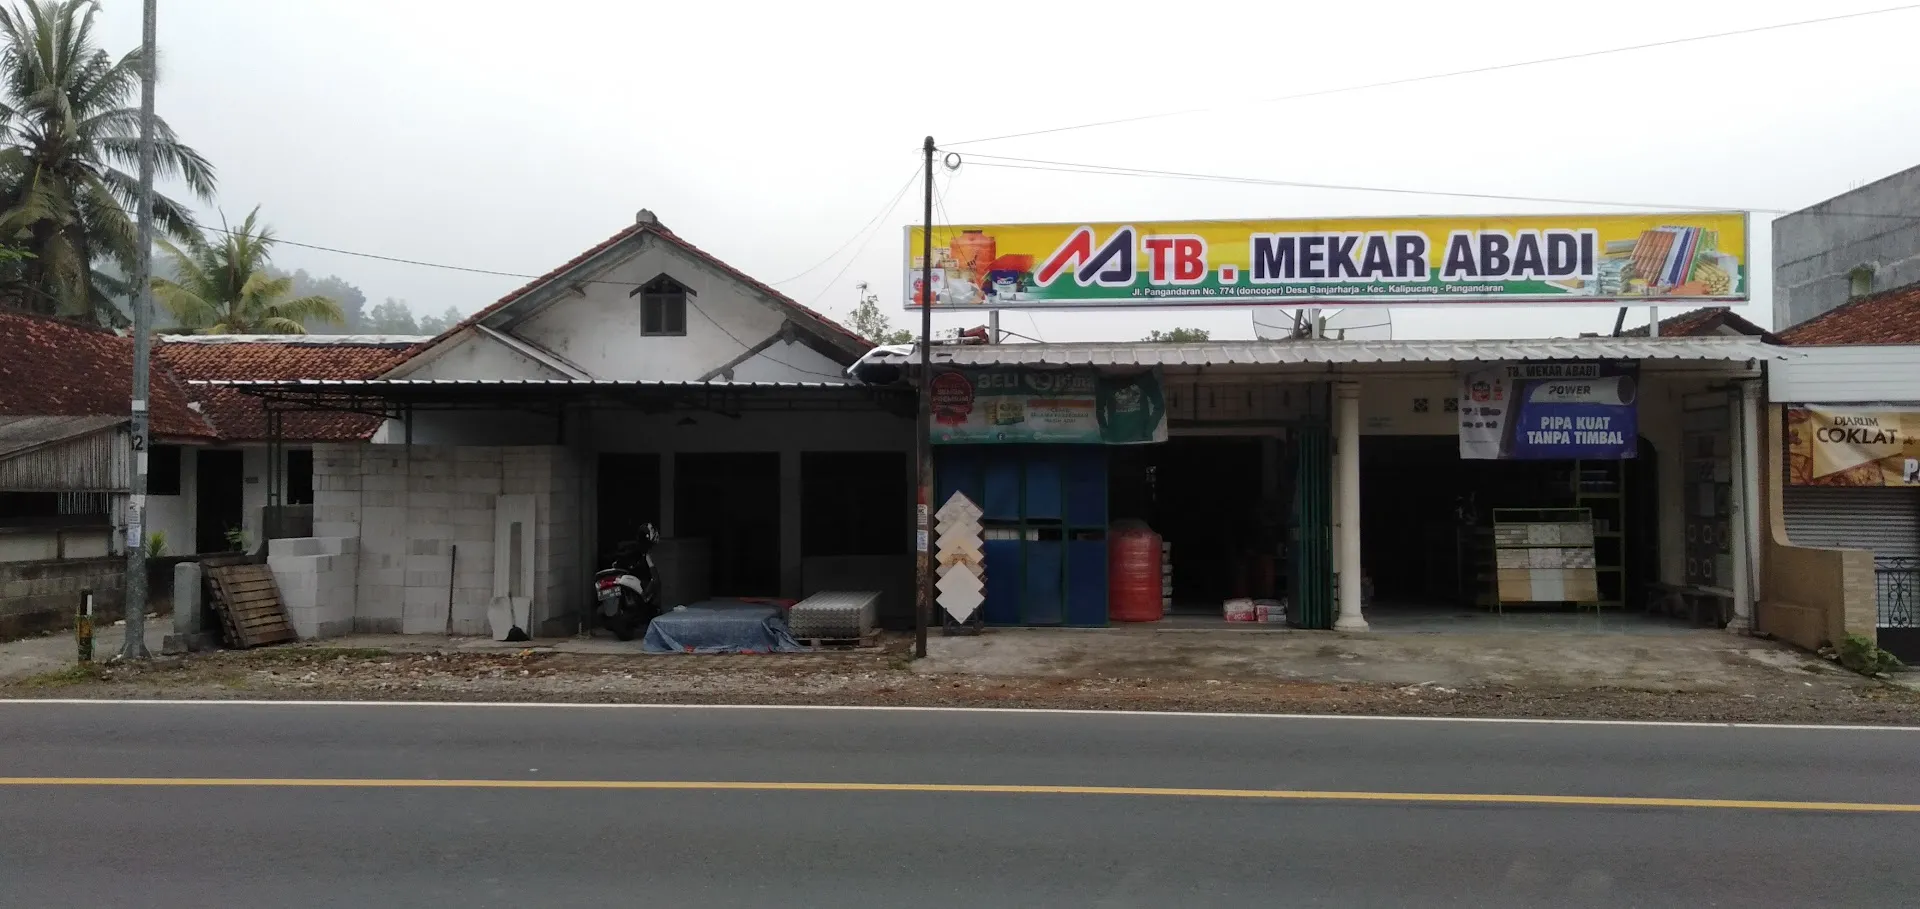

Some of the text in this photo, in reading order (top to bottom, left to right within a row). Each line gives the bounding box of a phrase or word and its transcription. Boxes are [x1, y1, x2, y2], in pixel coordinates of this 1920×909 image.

[1254, 235, 1426, 279] MEKAR
[1443, 233, 1593, 277] ABADI
[1132, 288, 1142, 296] Jl.
[1144, 288, 1201, 297] Pangandaran
[1202, 287, 1217, 295] No.
[1219, 287, 1234, 295] 774
[1236, 286, 1284, 296] (doncoper)
[1285, 286, 1308, 294] Desa
[1309, 285, 1360, 295] Banjarharja
[1367, 285, 1387, 293] Kec.
[1388, 284, 1438, 294] Kalipucang
[1446, 284, 1504, 293] Pangandaran
[1526, 365, 1562, 377] MEKAR
[1565, 365, 1597, 377] ABADI
[977, 372, 1019, 389] BELI
[1549, 384, 1592, 395] POWER
[1541, 416, 1611, 430] PIPA KUAT
[1834, 416, 1879, 427] DJARUM
[1527, 431, 1625, 445] TANPA TIMBAL
[1816, 427, 1898, 445] COKLAT
